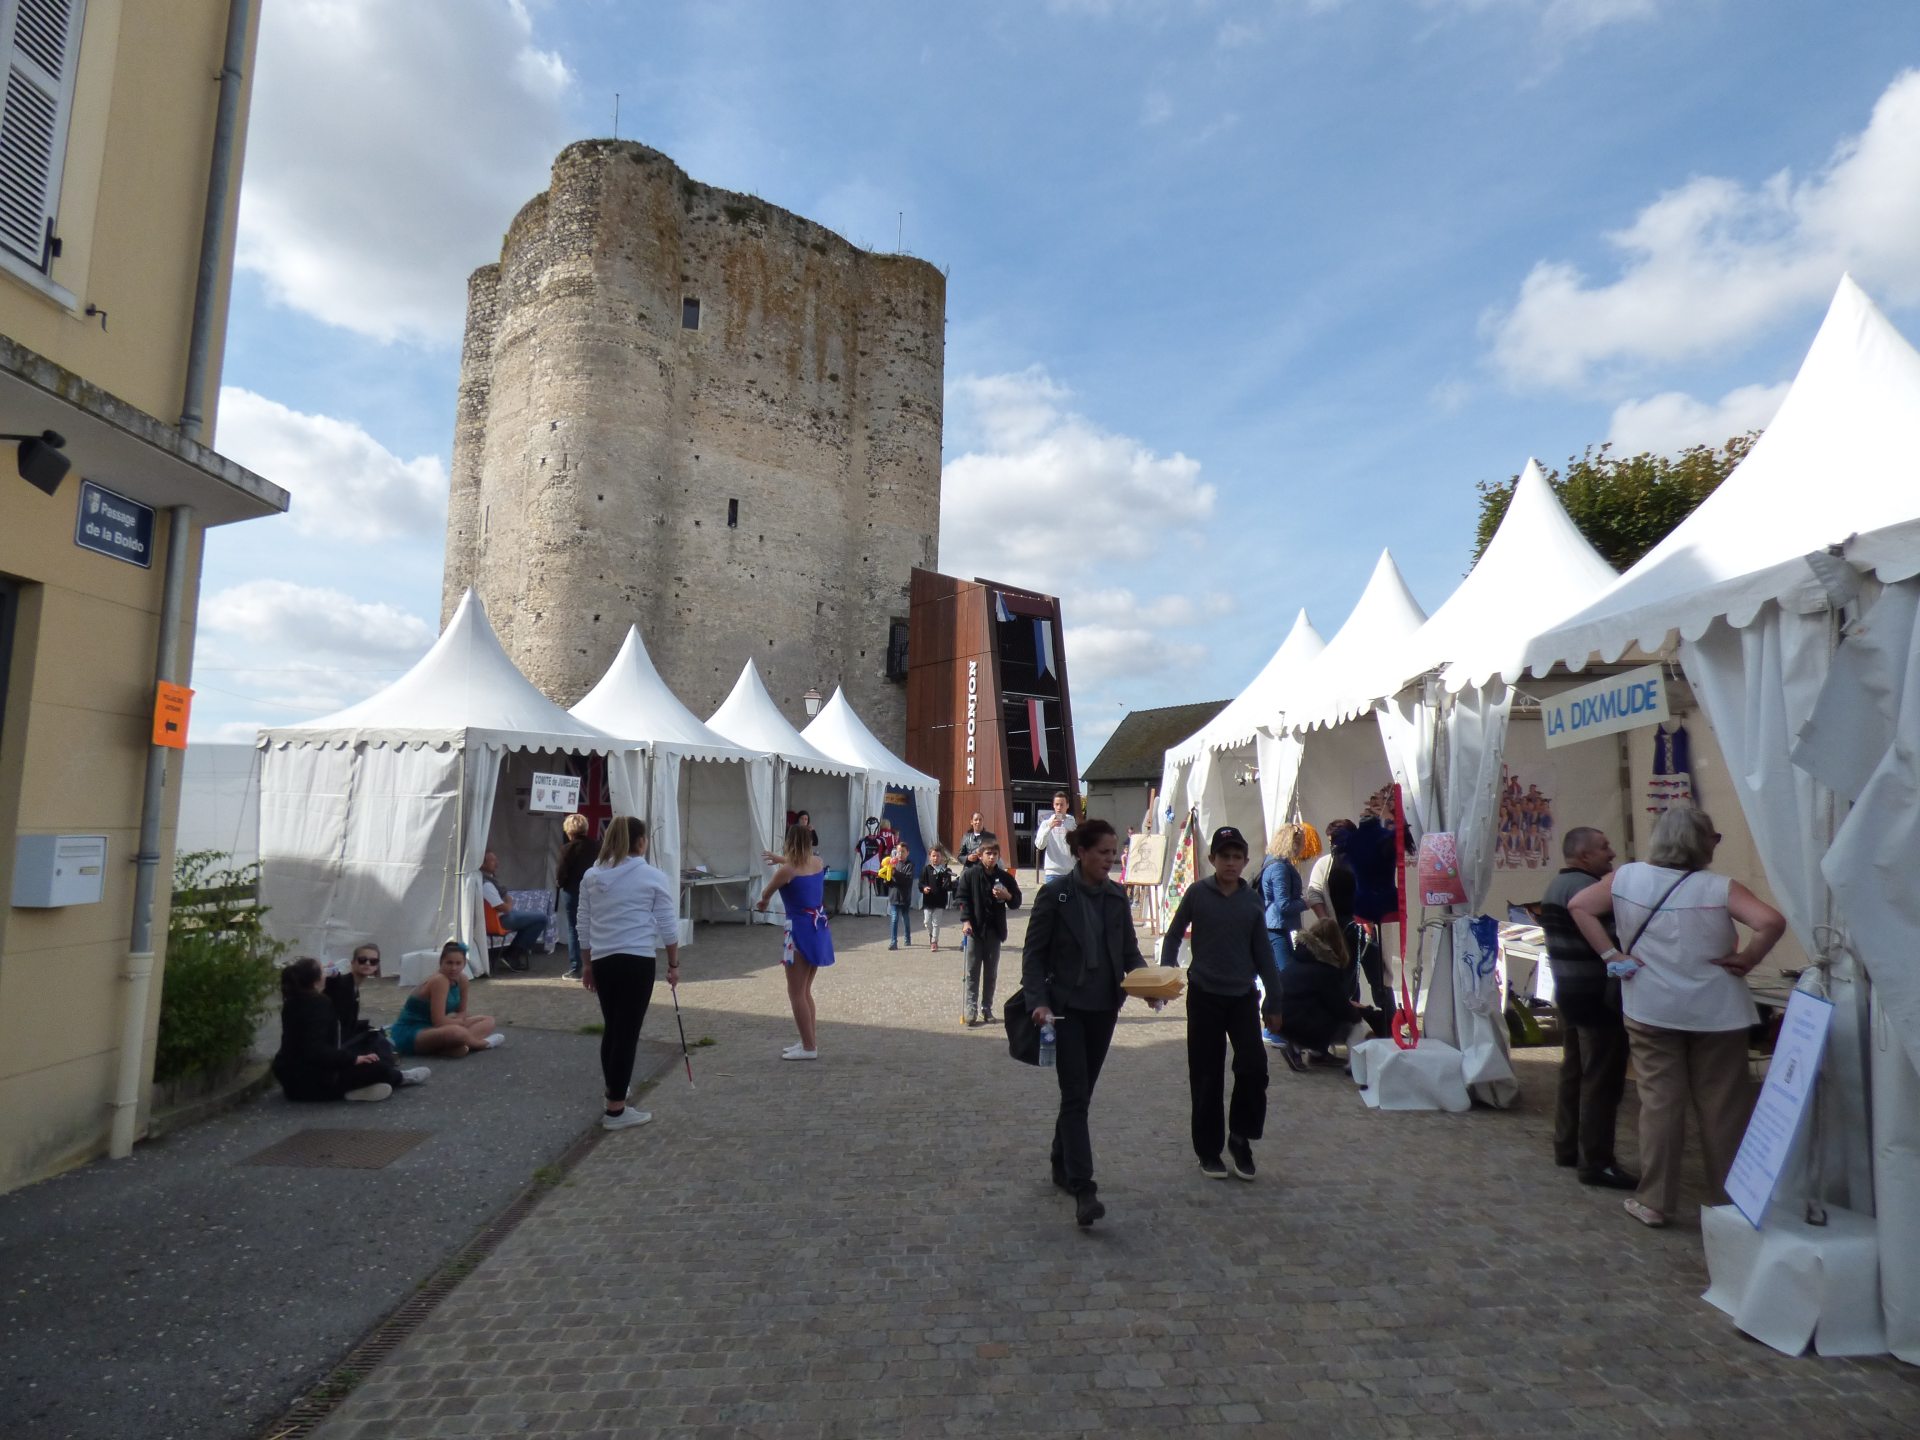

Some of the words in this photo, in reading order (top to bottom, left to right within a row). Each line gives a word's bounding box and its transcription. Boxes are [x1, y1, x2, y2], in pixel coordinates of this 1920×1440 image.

[100, 502, 136, 528] Passage
[85, 522, 100, 537] de
[102, 526, 112, 541] la
[967, 660, 977, 753] DONJON
[1548, 707, 1565, 736] LA
[1571, 679, 1657, 730] DIXMUDE
[967, 757, 975, 785] LE
